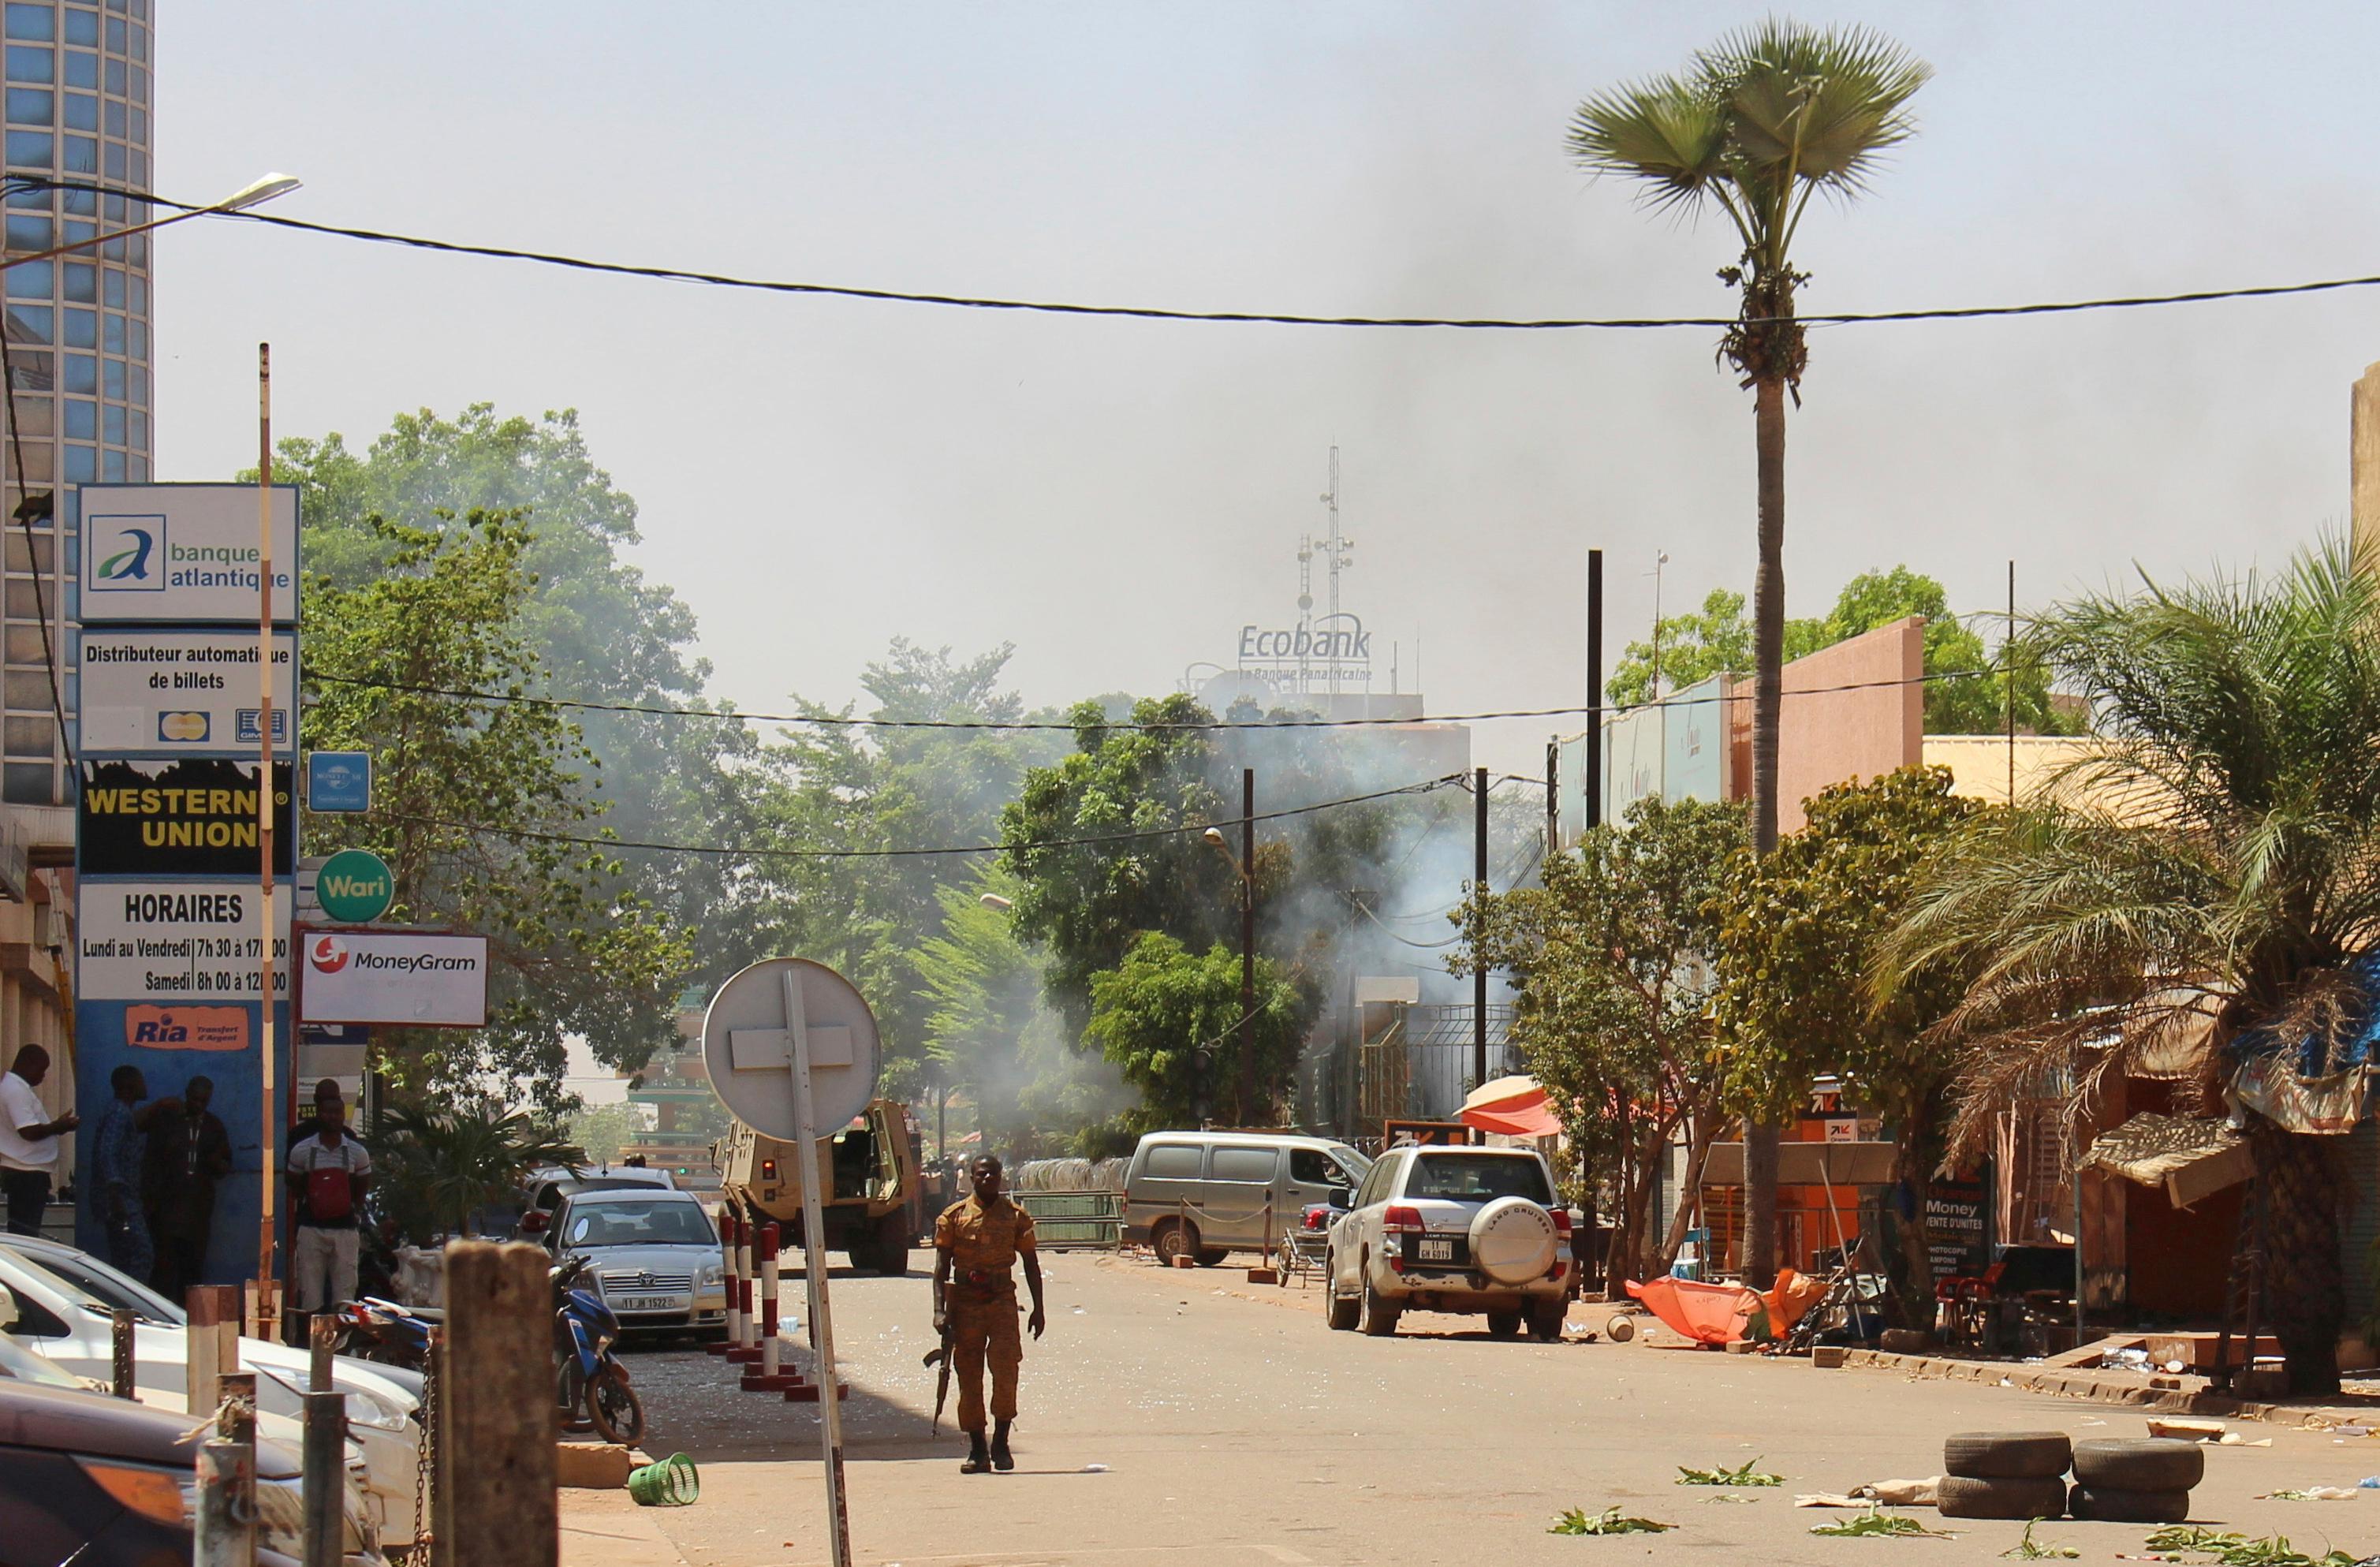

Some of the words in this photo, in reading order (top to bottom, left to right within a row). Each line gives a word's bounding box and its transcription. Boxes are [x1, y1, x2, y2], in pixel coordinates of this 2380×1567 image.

[171, 543, 259, 565] banque
[1240, 621, 1372, 658] Ecobank
[86, 645, 182, 663] Distributeur
[186, 646, 289, 663] automatiue
[149, 672, 169, 689] de
[174, 672, 224, 689] billets
[1254, 668, 1296, 681] Banque
[1300, 667, 1372, 681] Panafricaine
[87, 789, 256, 815] WESTERN
[142, 821, 256, 848] UNION
[324, 875, 385, 897] Wari
[125, 894, 243, 923] HORAIRES
[83, 938, 116, 957] Lundi
[119, 942, 133, 957] au
[137, 938, 190, 957] Vendredi
[197, 938, 213, 957] 7h
[216, 938, 231, 958] 30
[234, 938, 241, 957] à
[355, 952, 476, 974] MoneyGram
[145, 971, 190, 991] Samedi
[197, 971, 212, 991] 8h
[216, 972, 230, 991] 00
[234, 971, 241, 991] à
[134, 1013, 188, 1043] Ria
[197, 1026, 239, 1035] Transfert
[198, 1034, 237, 1043] d'Argent
[1926, 1200, 1977, 1218] Money
[1488, 1210, 1509, 1230] LAND
[1514, 1207, 1550, 1234] CRUISER
[1949, 1218, 1983, 1229] D'UNITES
[625, 1298, 632, 1308] 11
[649, 1297, 666, 1308] 1522
